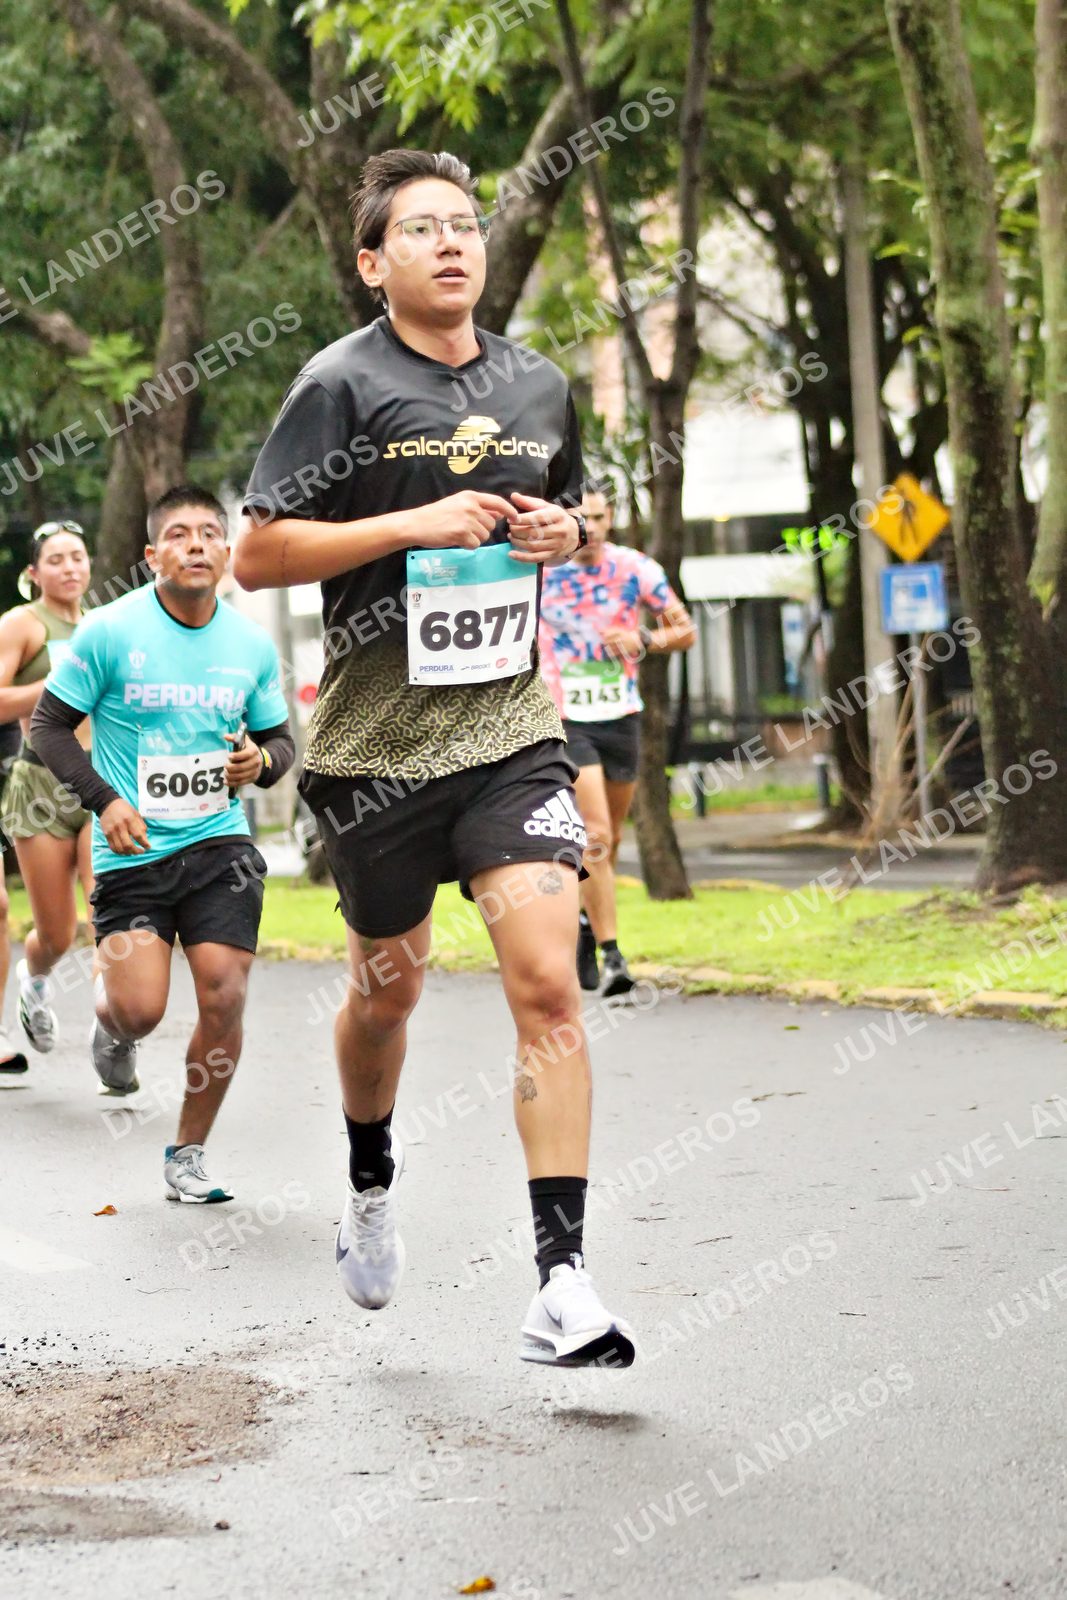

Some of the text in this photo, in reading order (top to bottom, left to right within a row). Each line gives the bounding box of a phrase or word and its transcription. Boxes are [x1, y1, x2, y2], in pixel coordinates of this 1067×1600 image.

[383, 436, 549, 459] salamandras
[420, 601, 529, 651] 6877
[419, 664, 454, 673] PERDURA
[124, 682, 245, 711] PERDURA
[146, 766, 225, 799] 6063
